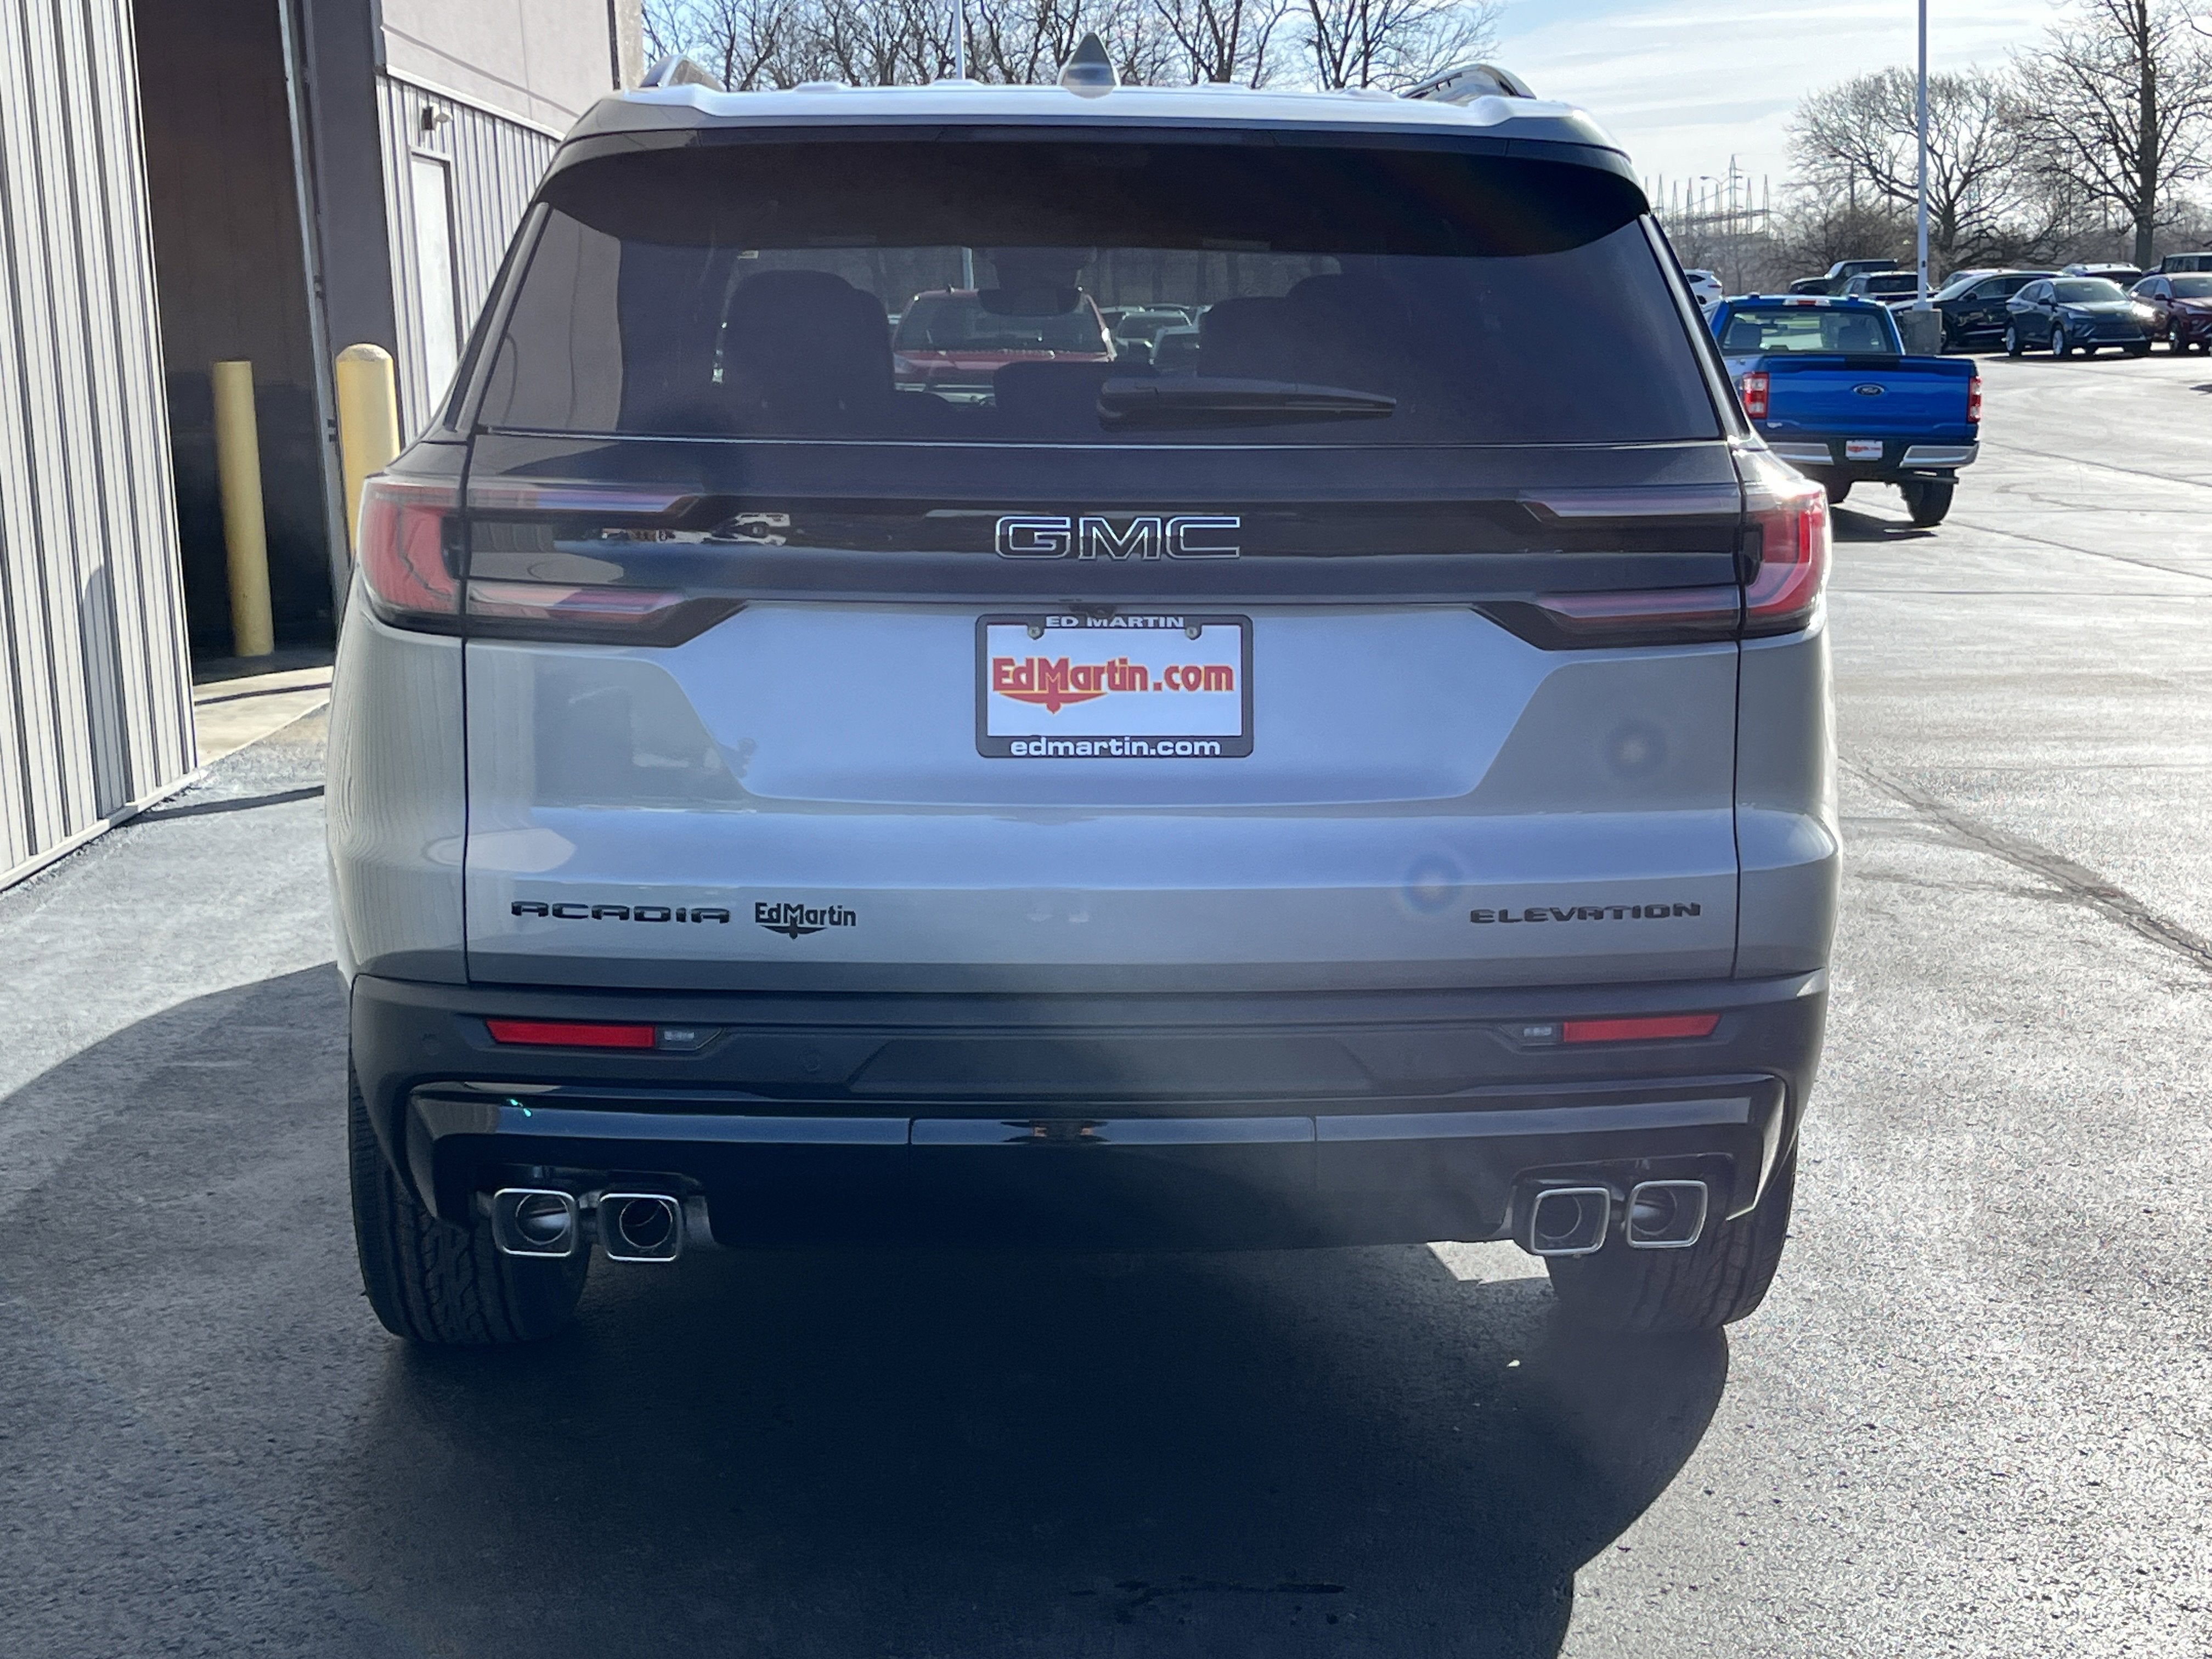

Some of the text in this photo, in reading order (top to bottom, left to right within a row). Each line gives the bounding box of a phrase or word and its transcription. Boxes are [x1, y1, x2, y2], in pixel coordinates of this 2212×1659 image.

[995, 516, 1241, 560] GMC
[1045, 616, 1184, 628] ED MARTIN
[992, 657, 1234, 692] EdMartin.com
[1009, 737, 1221, 757] edmartin.com
[511, 900, 731, 924] ACADIA
[754, 901, 857, 927] EdMartin
[1470, 902, 1701, 924] ELEVATION
